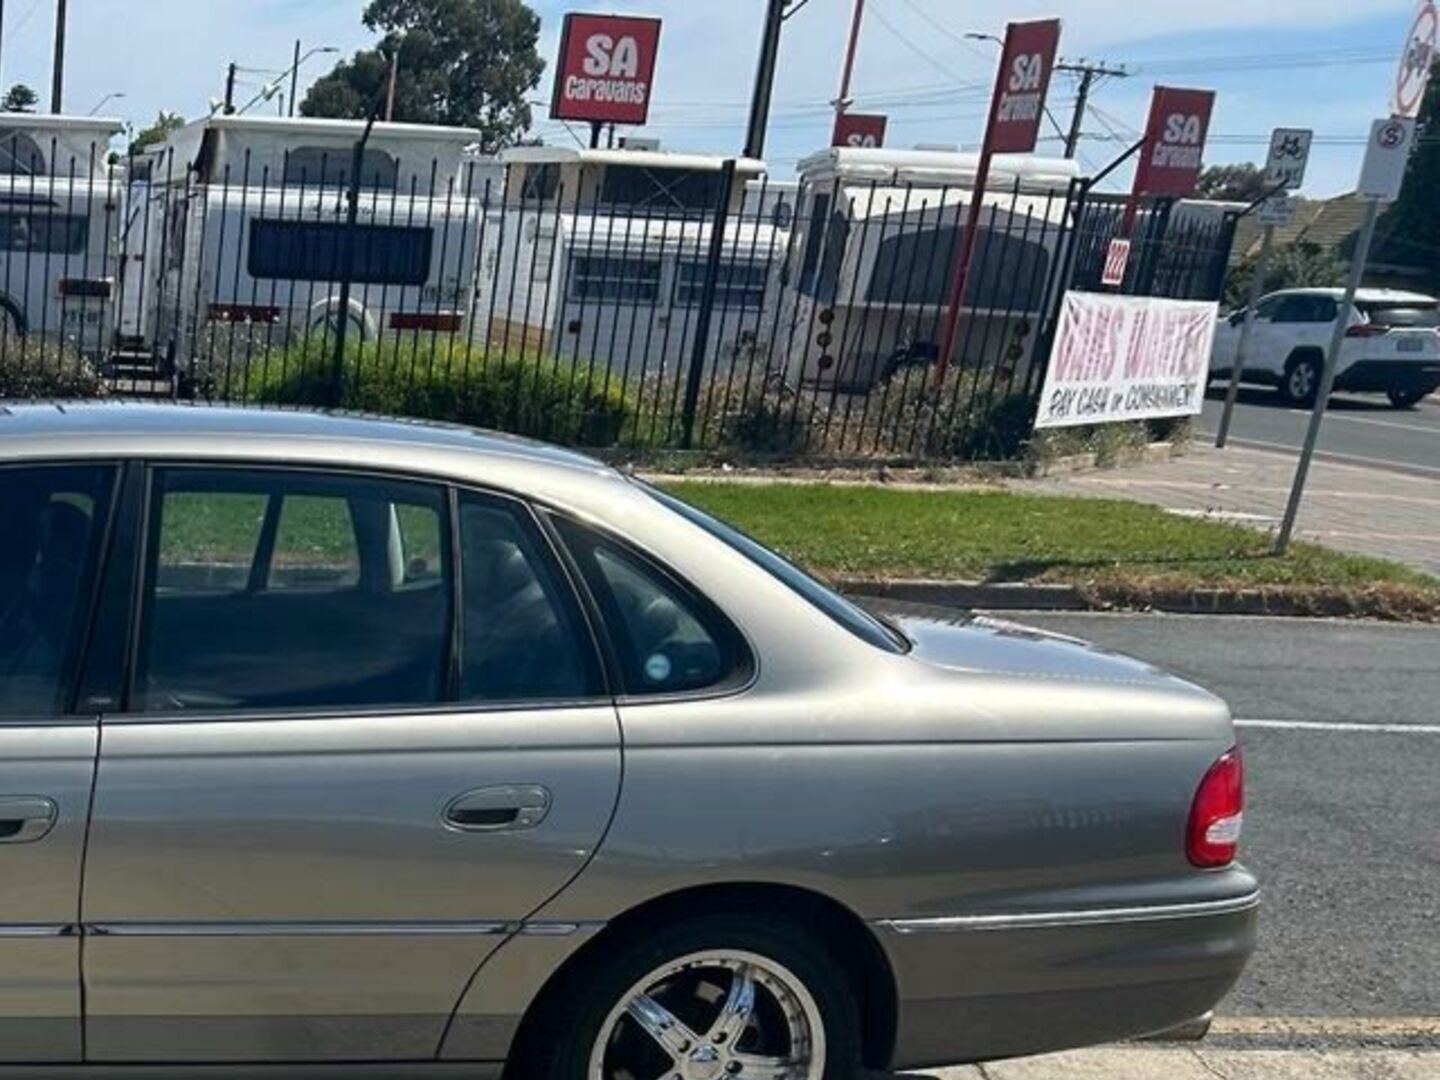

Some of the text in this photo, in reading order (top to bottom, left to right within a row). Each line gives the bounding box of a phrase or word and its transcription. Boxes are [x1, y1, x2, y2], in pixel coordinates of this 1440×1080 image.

[582, 33, 638, 78] SA
[1011, 54, 1043, 90] SA
[564, 75, 646, 104] Caravans
[1164, 113, 1201, 143] SA
